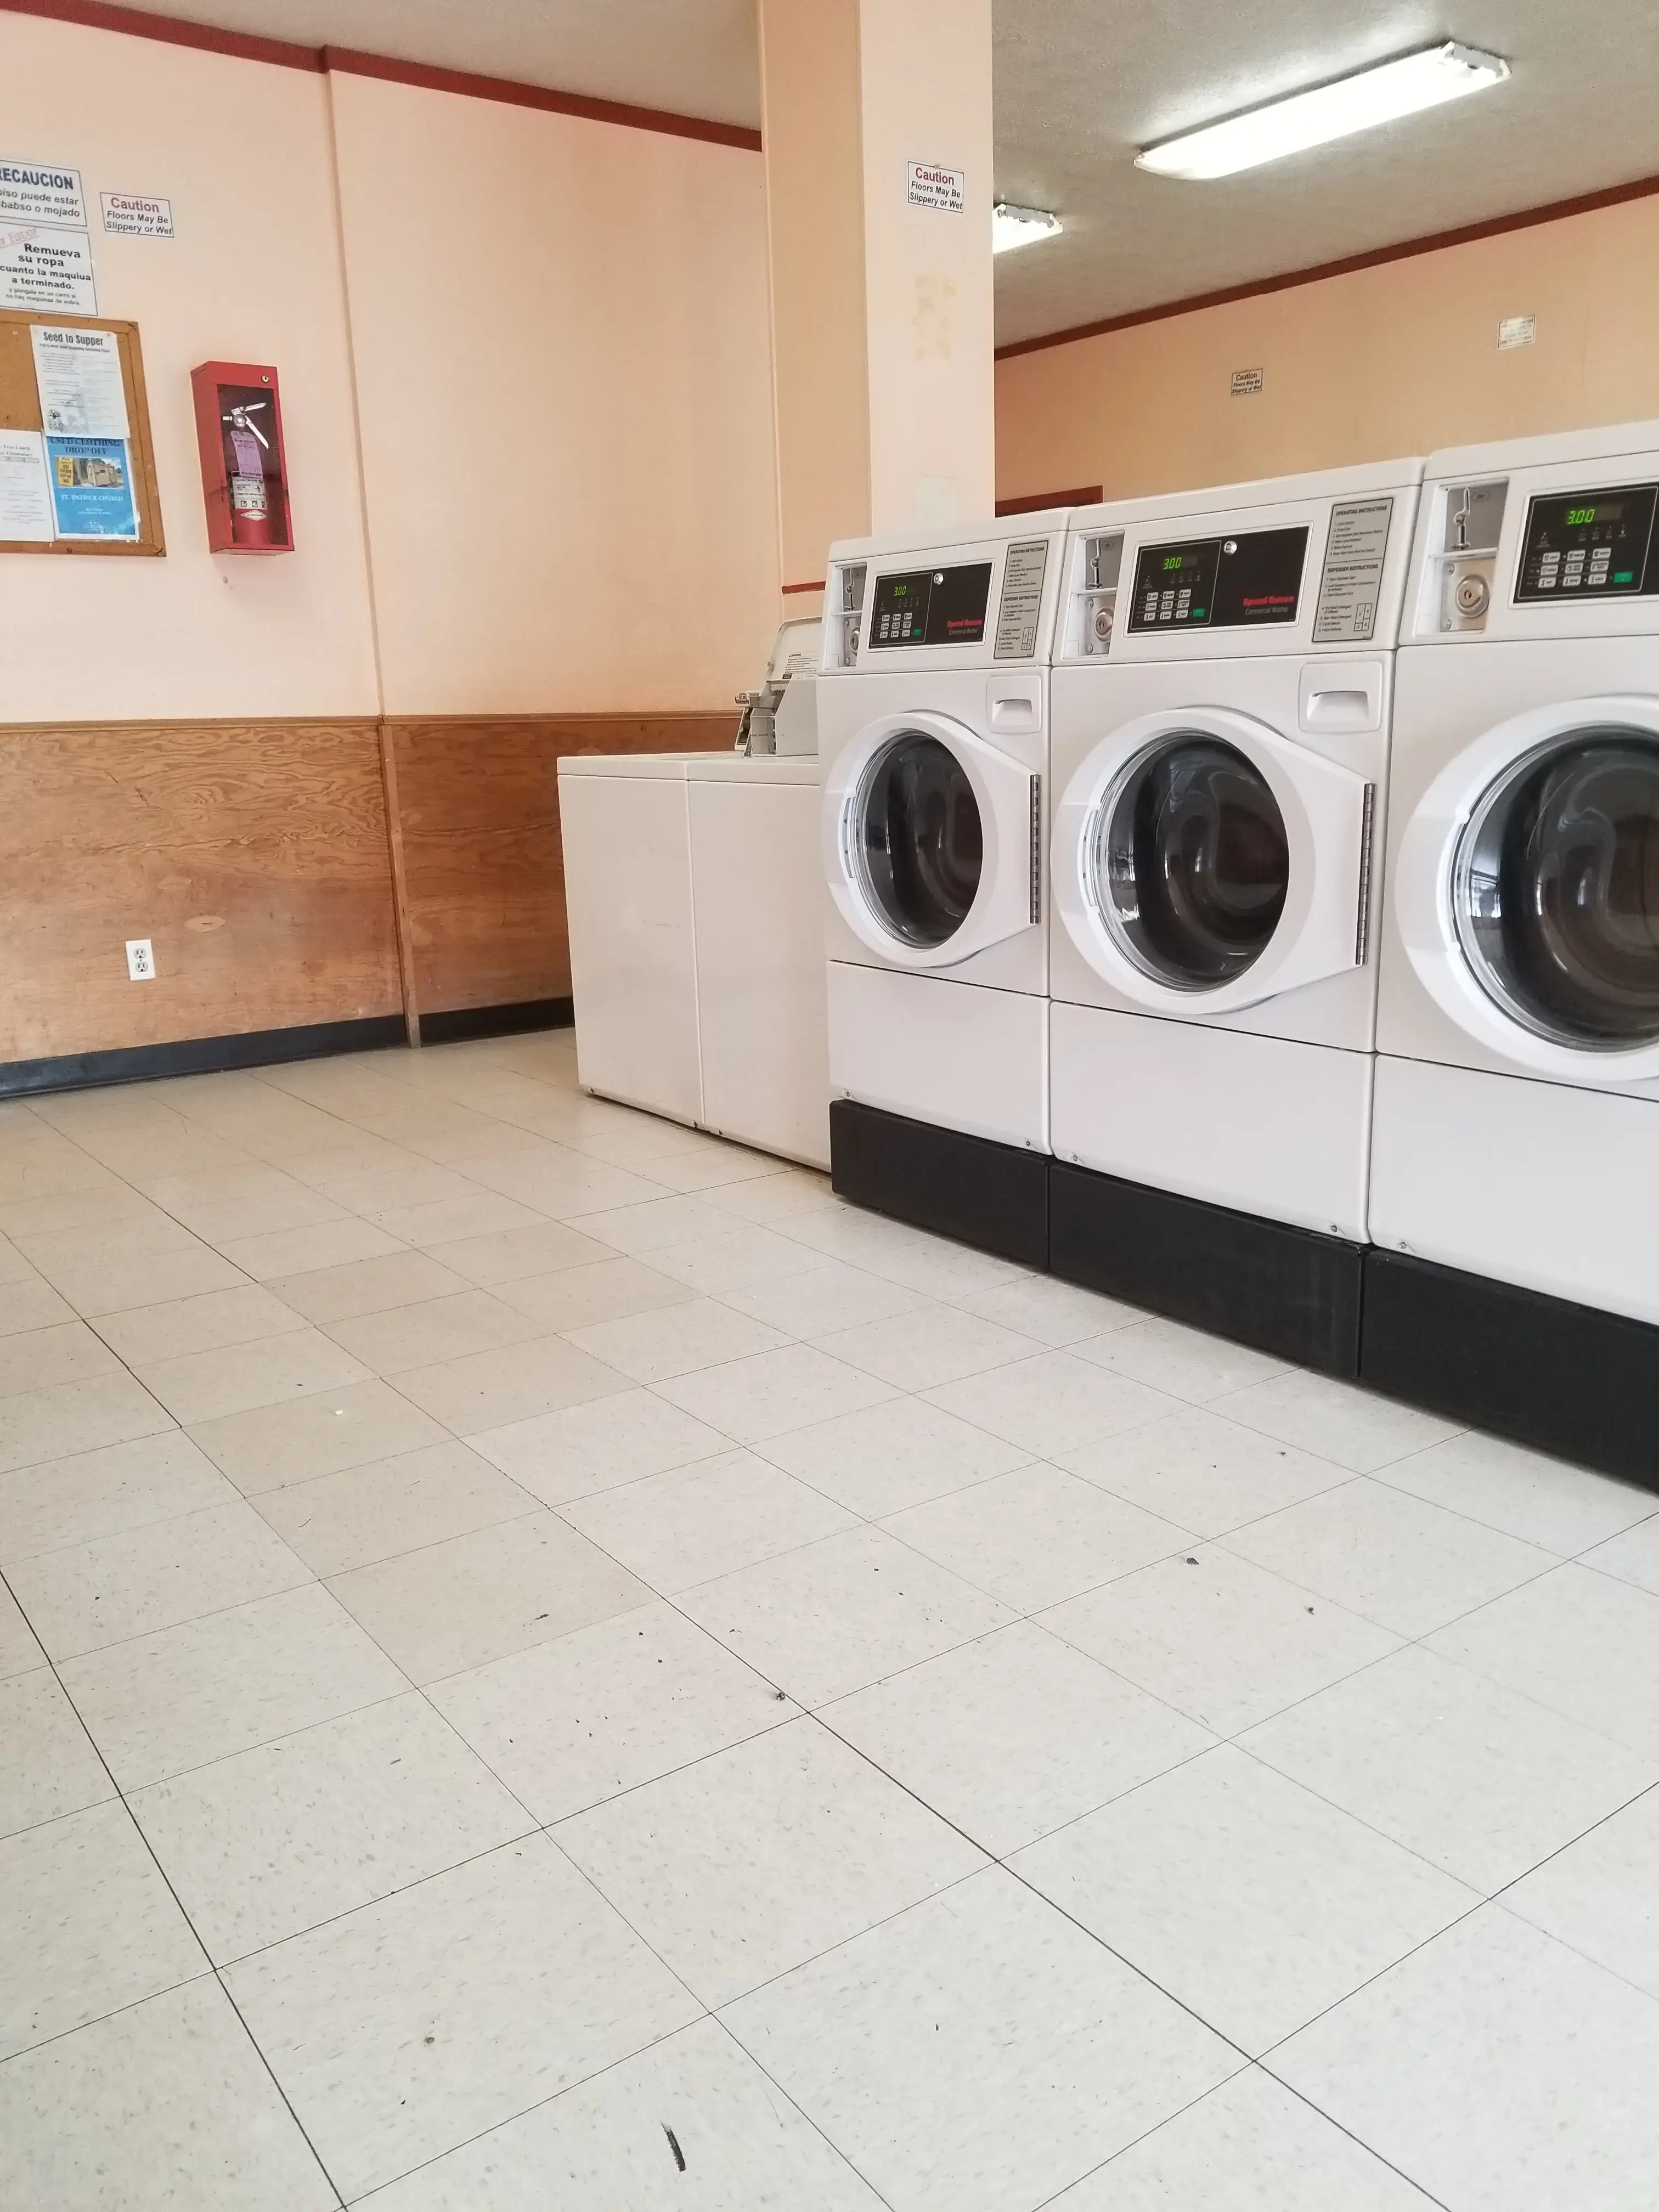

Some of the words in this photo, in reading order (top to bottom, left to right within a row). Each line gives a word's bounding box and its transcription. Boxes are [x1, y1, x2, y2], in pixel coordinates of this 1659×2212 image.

[0, 167, 74, 190] ECAUCION
[915, 167, 955, 185] Caution
[911, 180, 934, 193] Floors
[935, 185, 950, 198] May
[951, 189, 961, 198] Be
[21, 192, 52, 202] puede
[54, 196, 79, 205] estar
[111, 198, 160, 213] Caution
[910, 192, 938, 206] Slippery
[950, 199, 962, 210] Wet
[44, 206, 80, 217] mojado
[107, 210, 134, 221] Floors
[137, 213, 155, 224] May
[157, 216, 168, 224] Be
[106, 221, 142, 234] Slippery
[156, 226, 172, 235] Wet
[24, 243, 81, 258] Remueva
[37, 256, 64, 267] ropa
[0, 266, 34, 275] cuanto
[21, 277, 75, 289] terminado.
[43, 331, 64, 343] Seed
[65, 334, 74, 343] to
[76, 335, 104, 347] Supper
[1236, 373, 1257, 381] Caution
